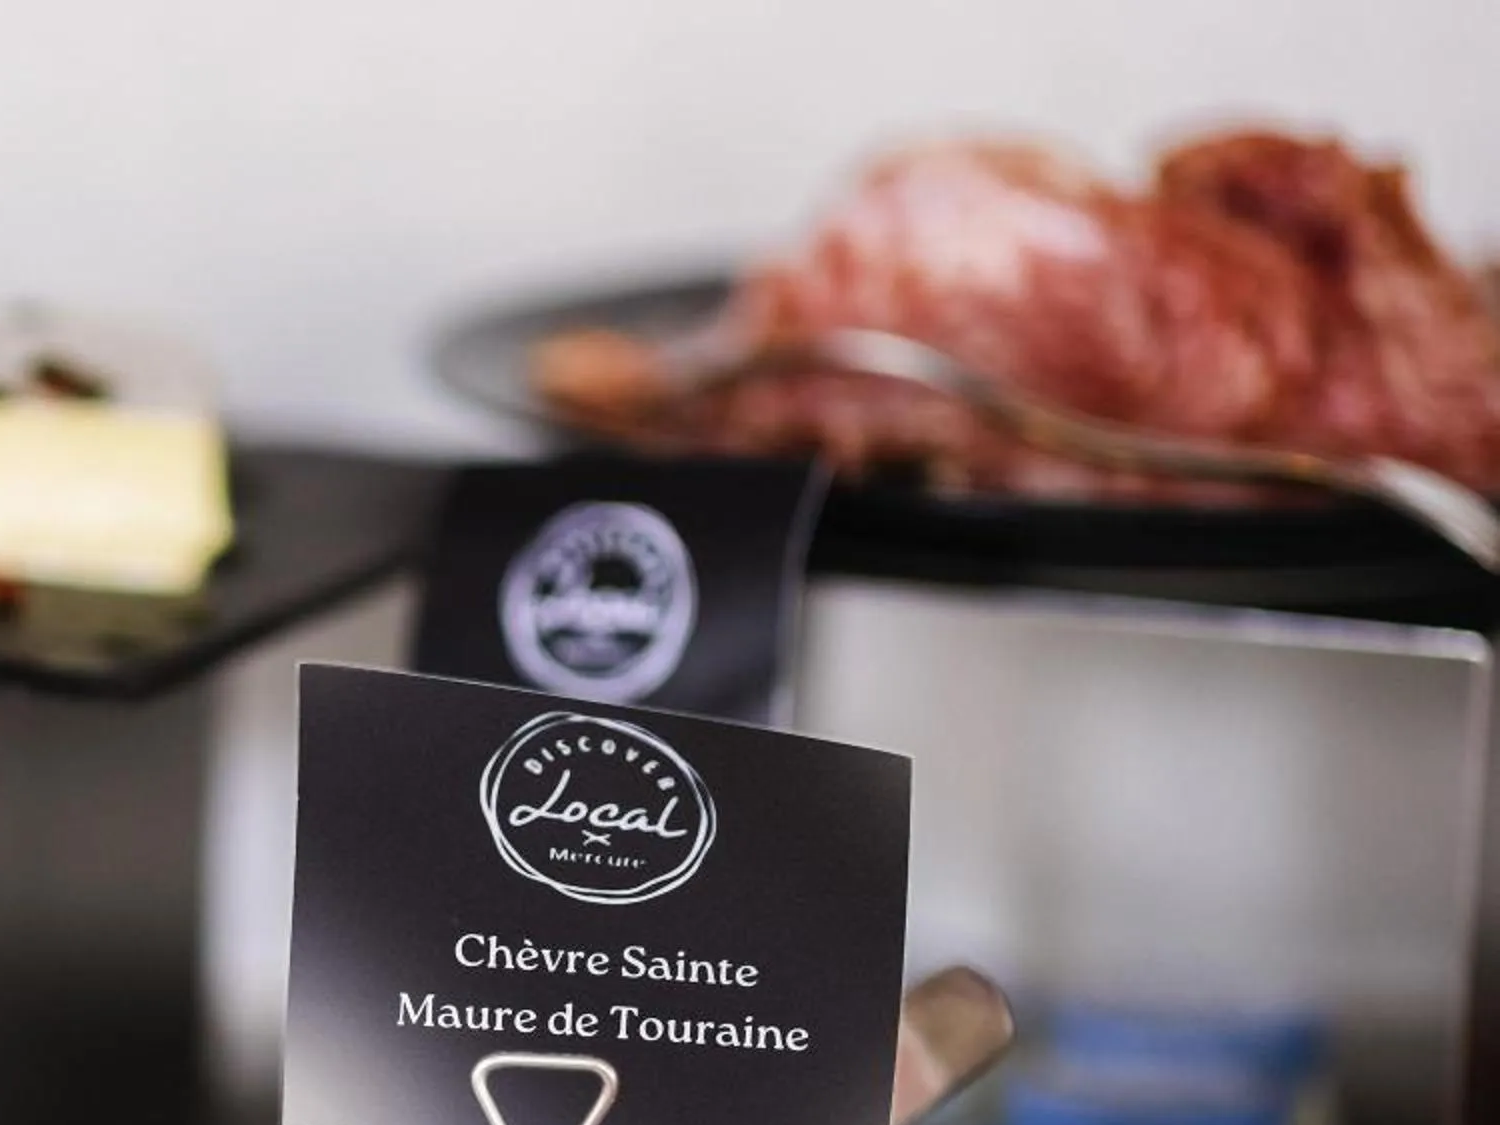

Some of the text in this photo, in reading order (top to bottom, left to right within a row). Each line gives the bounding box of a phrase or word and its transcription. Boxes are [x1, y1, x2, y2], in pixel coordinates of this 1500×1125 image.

[522, 735, 677, 792] DISCOVER
[507, 768, 689, 839] Local
[454, 932, 760, 988] Chèvre Sainte
[395, 991, 810, 1053] Maure de Touraine
